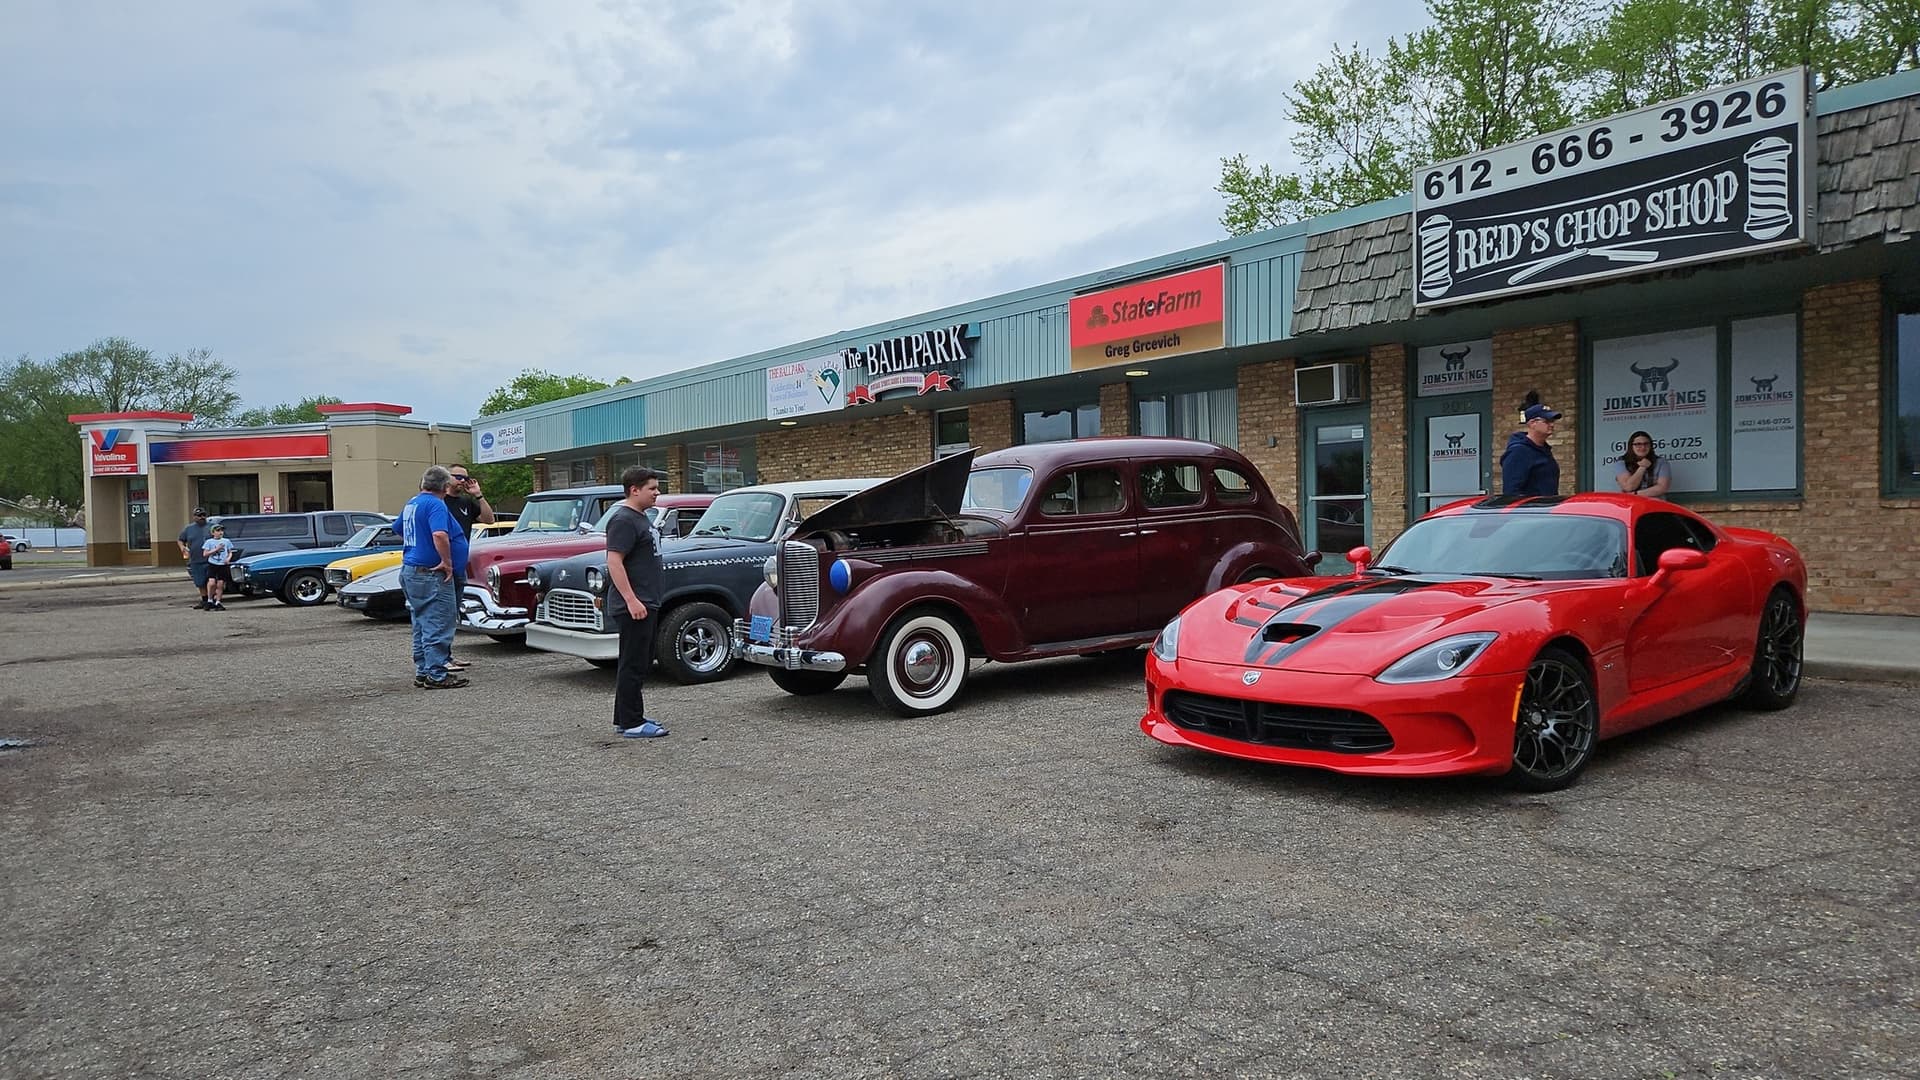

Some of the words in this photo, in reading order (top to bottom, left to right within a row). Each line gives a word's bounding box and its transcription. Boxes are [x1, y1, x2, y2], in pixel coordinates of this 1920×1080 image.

[1424, 159, 1492, 201] 612
[1531, 126, 1613, 175] 666
[1660, 81, 1787, 142] 3926
[1455, 217, 1550, 274] RED'S
[1555, 198, 1640, 249] CHOP
[1645, 170, 1740, 232] SHOP
[841, 348, 862, 370] The
[866, 325, 967, 376] BALLPARK
[1105, 344, 1131, 358] Greg
[1132, 333, 1181, 354] Grcevich
[1422, 368, 1488, 385] JOMSVIKINGS
[1603, 389, 1706, 411] JOMSVIKINGS
[1736, 391, 1793, 402] JOMSVIKINGS
[95, 453, 127, 461] Valvoline
[1432, 447, 1477, 457] JOMSVIKINGS
